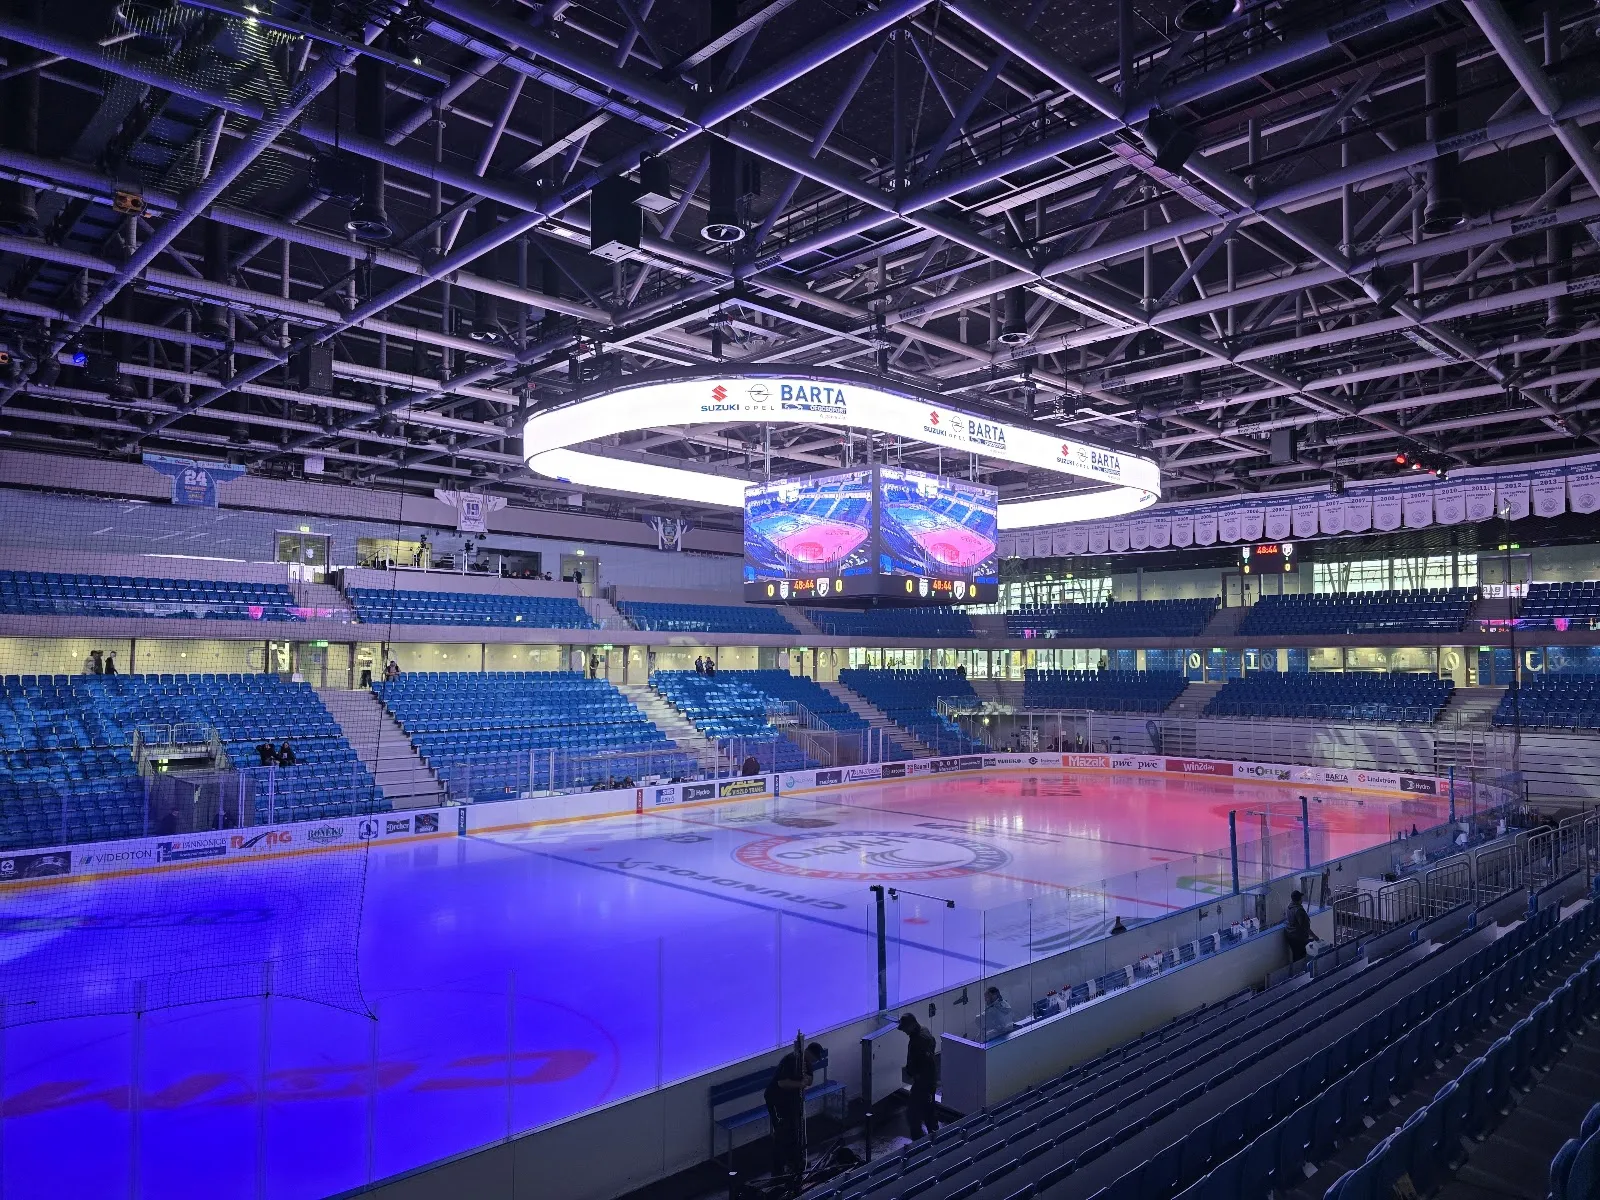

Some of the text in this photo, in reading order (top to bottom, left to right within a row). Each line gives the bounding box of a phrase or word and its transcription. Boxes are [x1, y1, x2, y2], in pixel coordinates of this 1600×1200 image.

[780, 384, 847, 406] BARTA
[700, 404, 740, 412] SUZUKI
[923, 425, 947, 437] SUZUKI
[968, 420, 1006, 443] BARTA
[1091, 451, 1121, 470] BARTA
[184, 469, 207, 487] 24
[1575, 474, 1594, 482] 2016
[466, 503, 479, 515] 19
[1256, 544, 1278, 554] 48:44
[767, 584, 775, 597] 0
[794, 580, 815, 590] 48:44
[835, 579, 843, 593] 0
[906, 579, 913, 593] 0
[932, 580, 952, 590] 48:44
[969, 584, 977, 598] 0
[1068, 755, 1106, 767] Mazak
[1112, 758, 1133, 768] pwc
[1137, 760, 1158, 770] pwc
[1325, 773, 1349, 781] BARTA
[1415, 782, 1431, 790] Hydro
[695, 788, 711, 797] Hydro
[387, 823, 409, 832] Dreher
[776, 838, 910, 860] Hydro
[95, 850, 152, 863] VIDEOTON
[647, 865, 847, 910] GRUNDFOS
